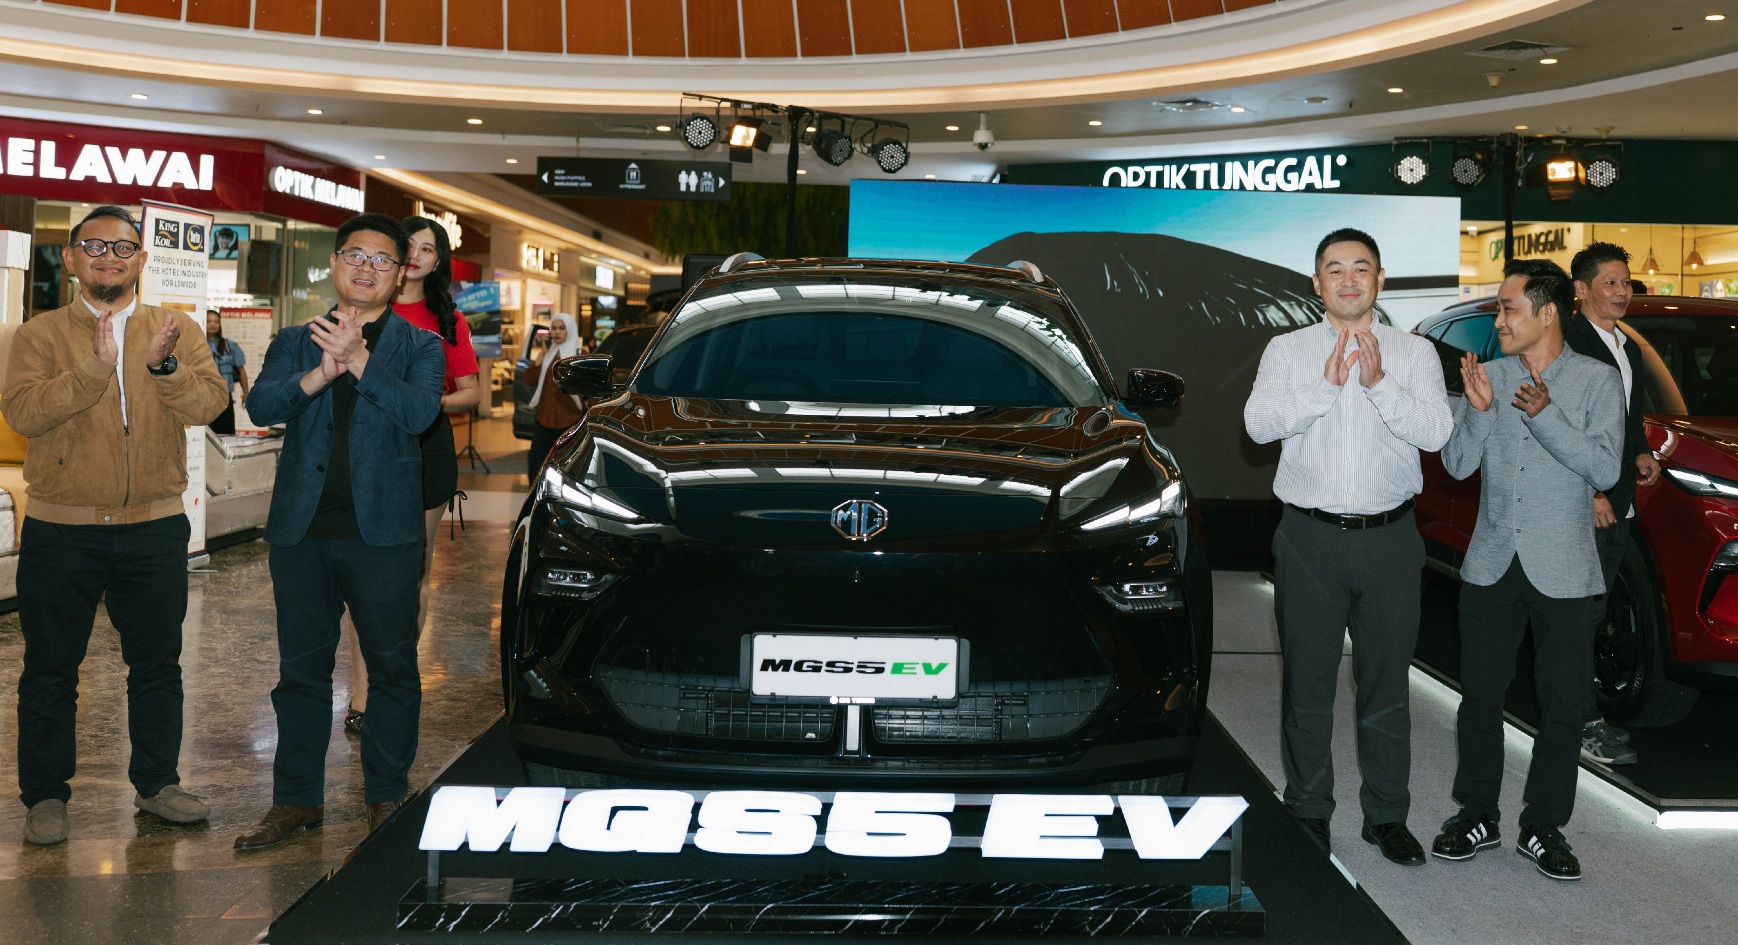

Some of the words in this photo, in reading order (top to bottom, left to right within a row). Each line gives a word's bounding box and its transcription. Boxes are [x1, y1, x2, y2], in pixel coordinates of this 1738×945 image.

[0, 137, 214, 191] ELAWAI
[274, 166, 315, 200] OPTIK
[314, 177, 365, 213] MELAWAI
[159, 220, 178, 233] KING
[154, 255, 179, 266] PROUDLY
[180, 258, 205, 268] SERVING
[148, 266, 160, 275] THE
[162, 268, 179, 277] HOTEL
[180, 270, 207, 279] INDUSTRY
[162, 279, 197, 289] WORLDWIDE
[760, 659, 886, 675] MGS5
[890, 662, 949, 675] EV
[419, 786, 955, 858] MGS5
[981, 793, 1250, 861] EV
